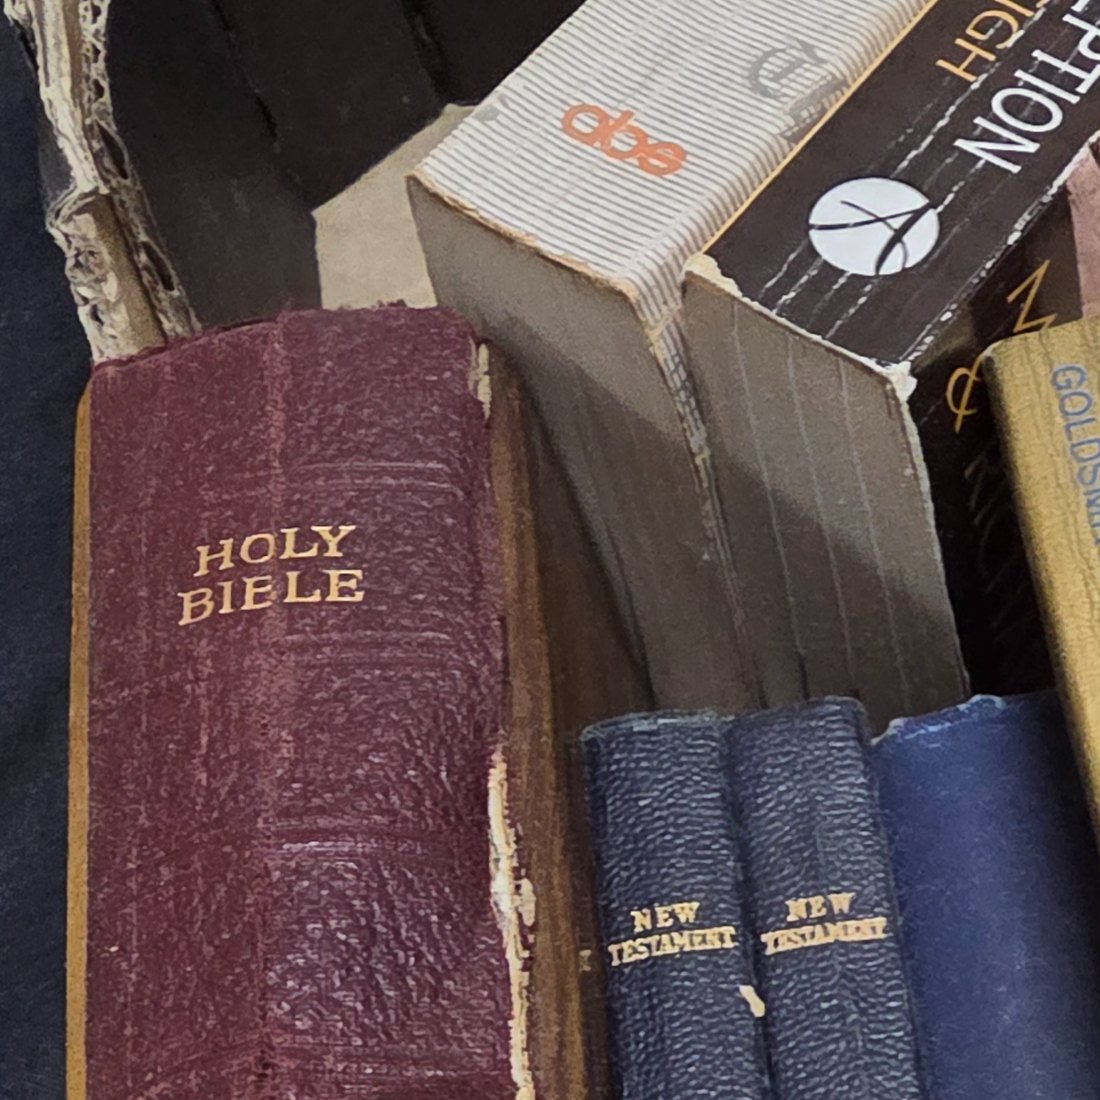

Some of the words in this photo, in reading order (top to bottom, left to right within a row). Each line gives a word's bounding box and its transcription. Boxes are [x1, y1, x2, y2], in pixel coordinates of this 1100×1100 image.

[936, 0, 1048, 82] IGH
[561, 102, 688, 178] abs
[192, 524, 357, 578] HOLY
[176, 568, 366, 627] BIBLE
[629, 900, 701, 934] NEW
[784, 891, 856, 923] NEW
[607, 925, 738, 967] TESTAMENT
[760, 916, 889, 956] TESTAMENT
